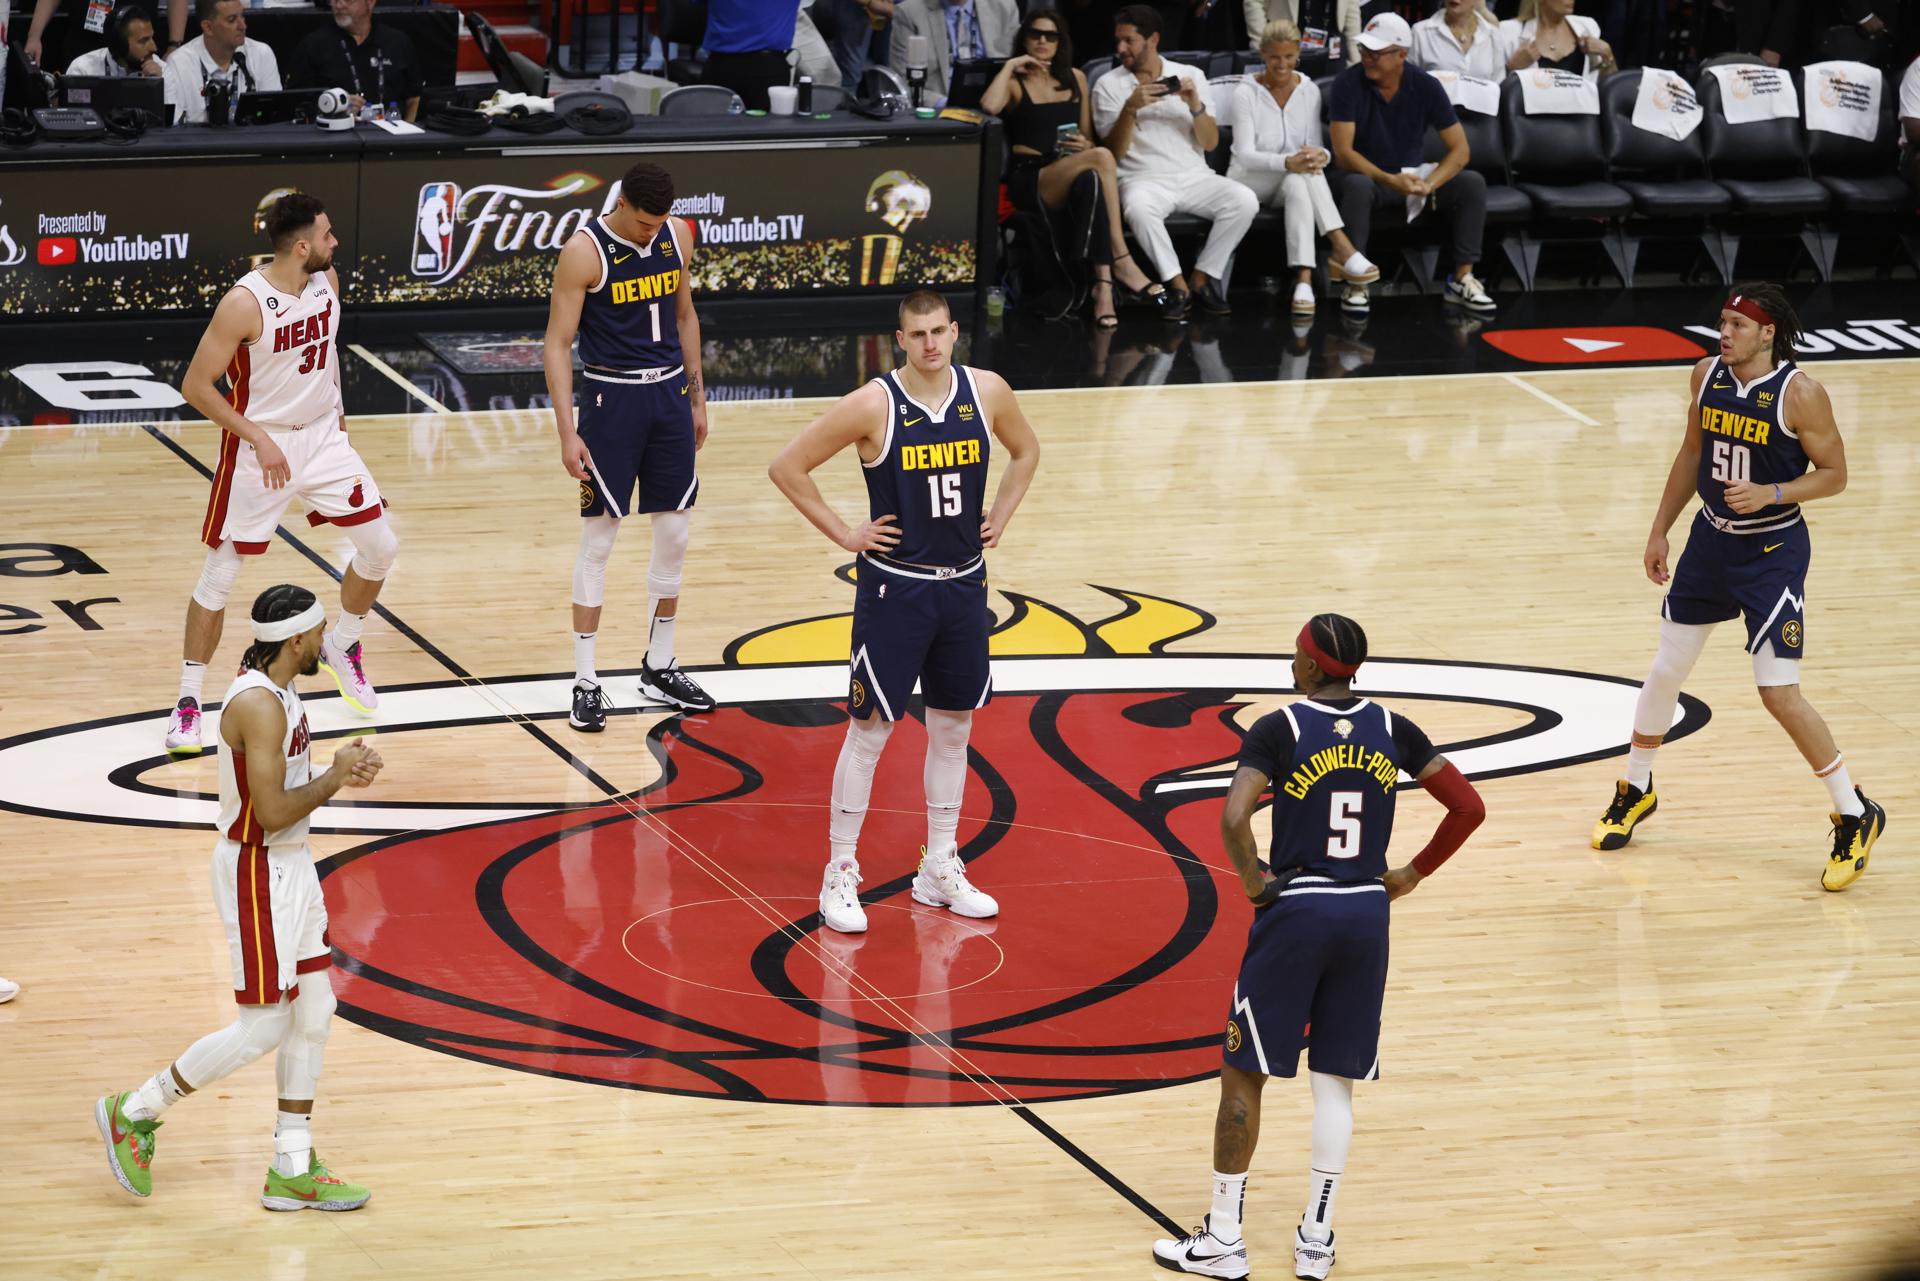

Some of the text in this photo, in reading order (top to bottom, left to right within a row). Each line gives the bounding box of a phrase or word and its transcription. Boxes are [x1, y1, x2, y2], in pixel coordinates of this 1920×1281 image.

[670, 192, 726, 216] esented by
[38, 211, 107, 235] Presented by
[608, 244, 616, 254] 6
[268, 298, 277, 309] 6
[611, 269, 682, 305] DENVER
[273, 298, 333, 353] HEAT
[649, 303, 662, 342] 1
[298, 339, 330, 375] 31
[1716, 370, 1724, 379] 6
[9, 361, 188, 411] 6
[1759, 390, 1774, 401] WU
[900, 404, 907, 415] 6
[957, 403, 973, 413] WU
[1702, 406, 1771, 446] DENVER
[901, 439, 980, 471] DENVER
[1711, 439, 1751, 482] 50
[927, 472, 962, 518] 15
[1283, 744, 1399, 800] CALDWELL-POPE
[1326, 791, 1363, 859] 5
